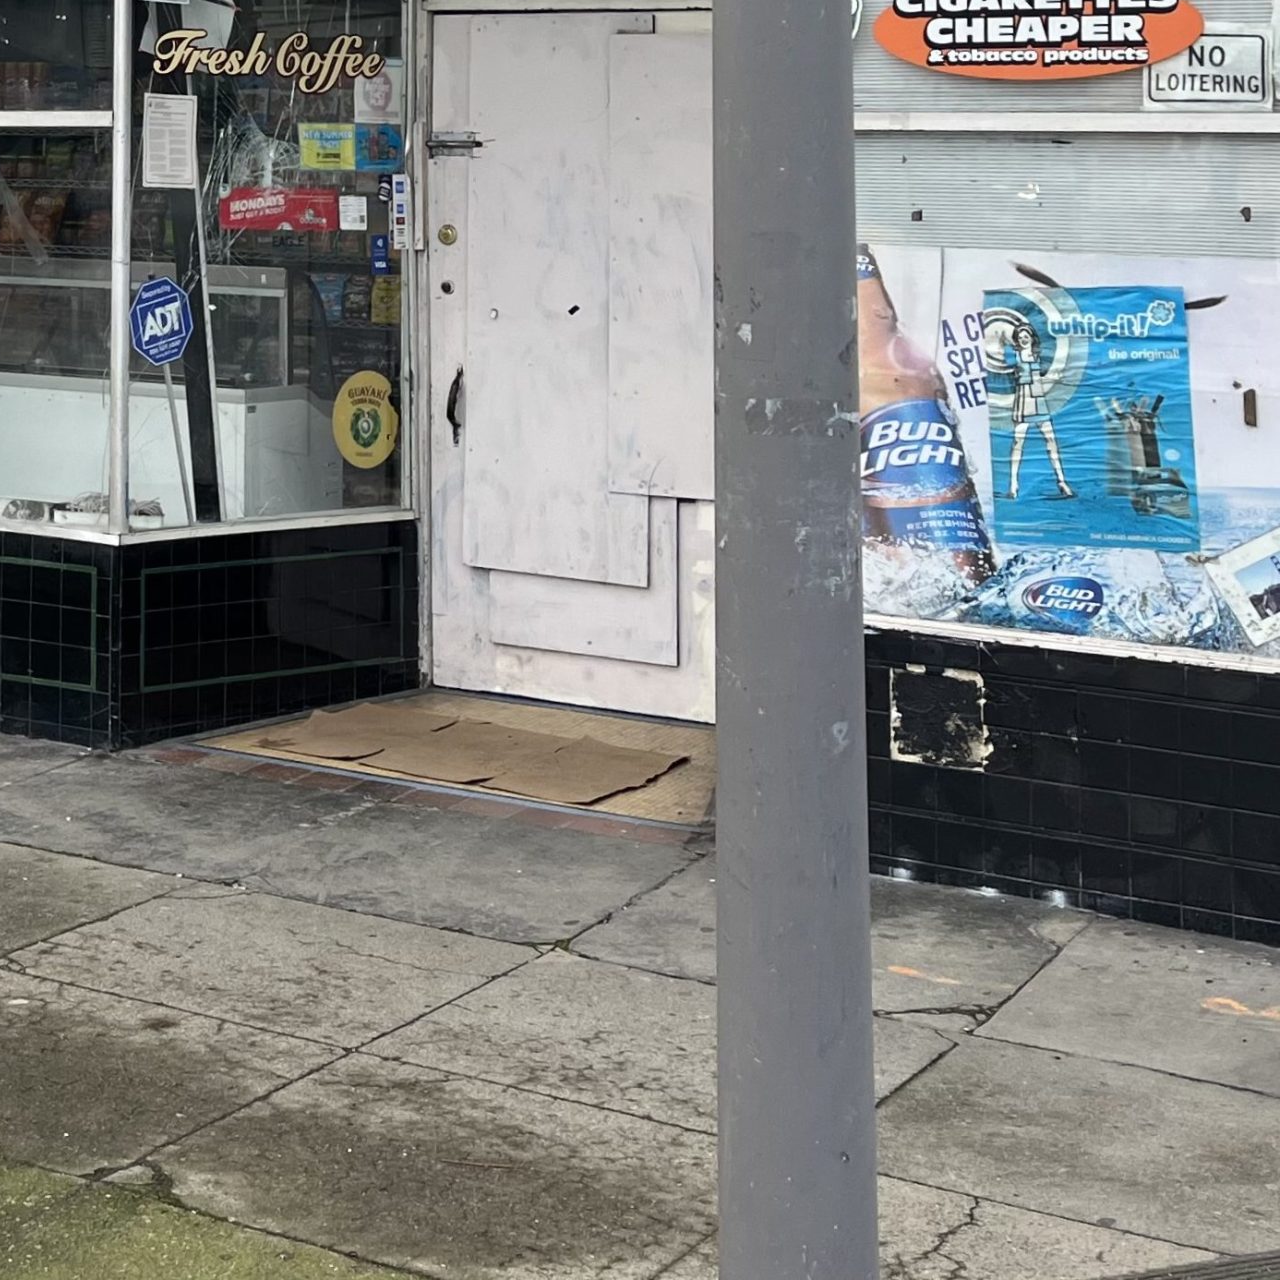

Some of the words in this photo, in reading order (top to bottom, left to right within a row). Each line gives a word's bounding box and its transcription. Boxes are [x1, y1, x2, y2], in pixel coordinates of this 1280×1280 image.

[923, 14, 1148, 48] CHEAPER
[152, 28, 272, 78] Fresh
[273, 31, 387, 95] Coffee
[928, 48, 945, 65] &
[947, 47, 1038, 64] tobacco
[1043, 47, 1150, 67] products
[1189, 45, 1227, 67] NO
[1154, 74, 1260, 94] LOITERING
[144, 301, 180, 342] ADT
[942, 320, 957, 347] A
[1048, 313, 1151, 342] whip-it!
[1108, 348, 1128, 360] the
[868, 420, 953, 449] BUD
[860, 443, 964, 478] LIGHT
[1036, 595, 1102, 614] LIGHT
[1045, 584, 1095, 601] BUD
